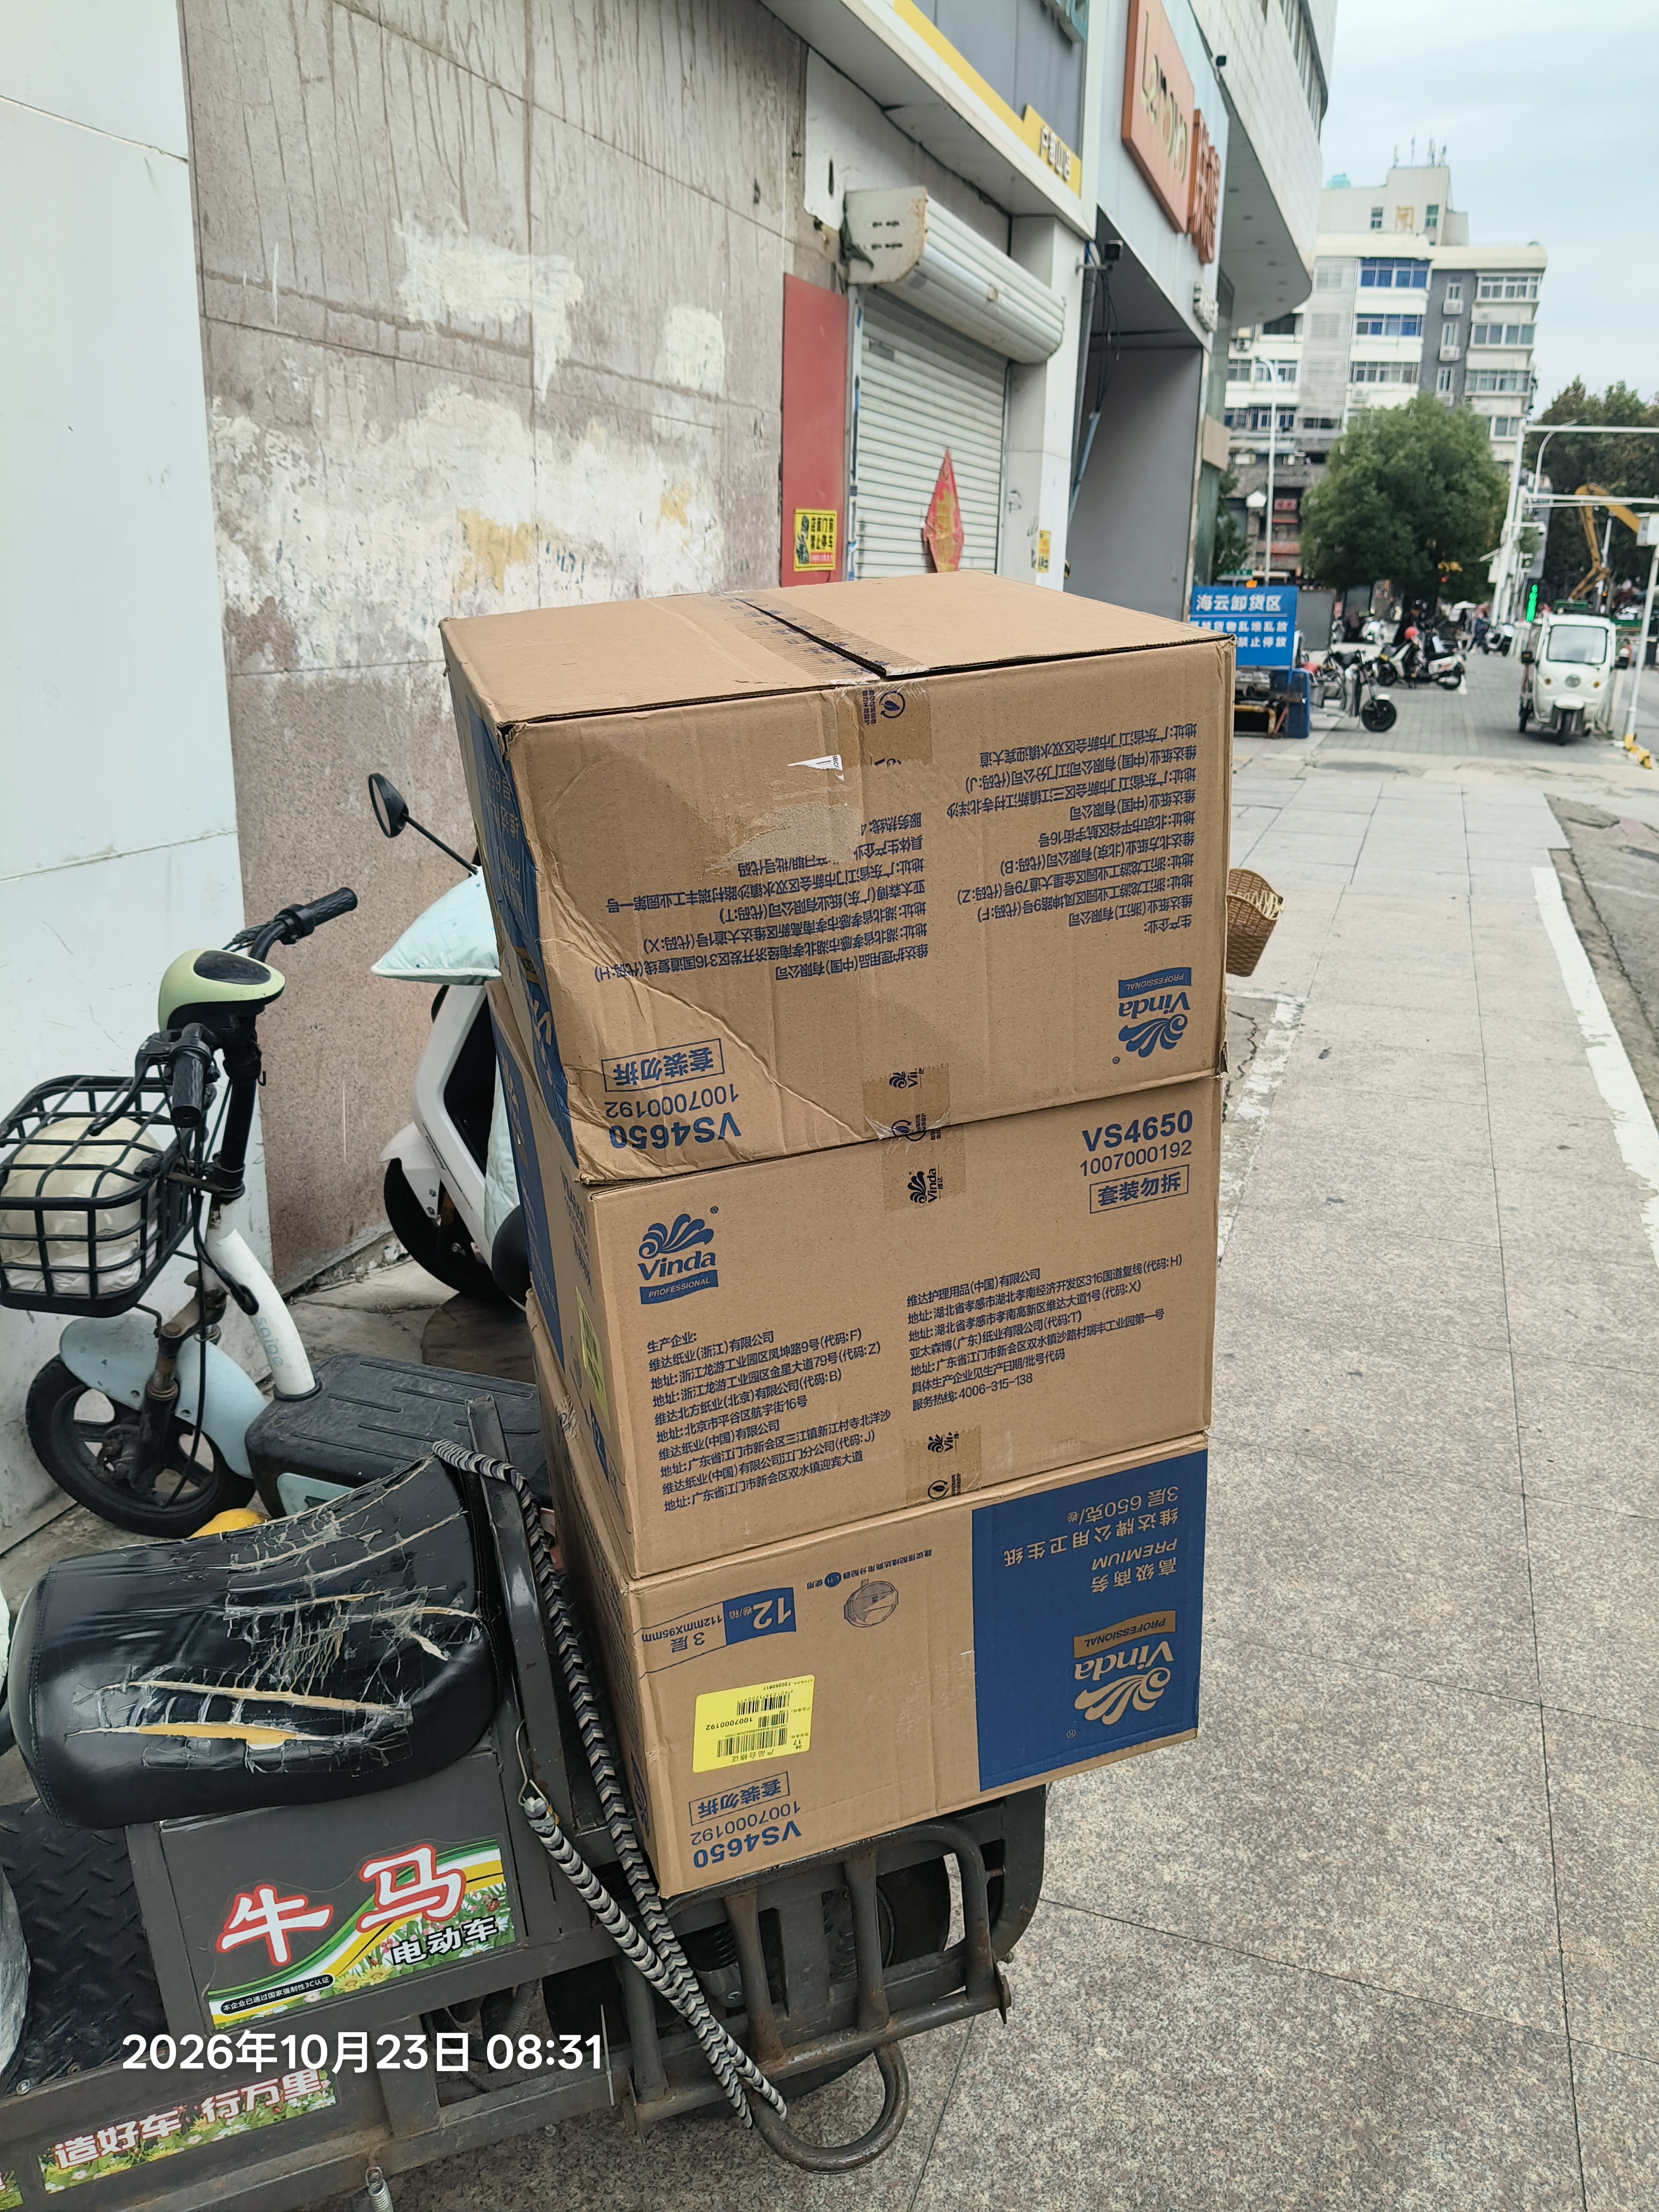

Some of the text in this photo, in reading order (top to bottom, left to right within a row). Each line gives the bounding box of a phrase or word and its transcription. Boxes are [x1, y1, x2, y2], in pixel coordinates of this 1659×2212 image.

[1070, 790, 1196, 822] 维达纸业(中国)有限公司
[1000, 833, 1195, 877] 维达北方纸业(北京)有限公司(代码:B)
[719, 880, 925, 925] 亚太森博(广东)纸业有限公司(代码:T)
[1069, 895, 1192, 928] 维达纸业(浙江)有限公司
[1143, 915, 1192, 934] 生产企业:
[775, 945, 928, 981] 维达护理用品(中国)有限公司
[1125, 973, 1185, 991] PROFESSIONAL
[1118, 992, 1191, 1019] Vinda
[613, 1047, 714, 1086] 套装勿拆
[604, 1083, 739, 1118] 1007000192
[609, 1112, 742, 1150] VS4650
[1081, 1109, 1193, 1152] VS4650
[1080, 1139, 1192, 1177] 1007000192
[927, 1168, 938, 1203] Vinda
[1097, 1171, 1181, 1208] 套装勿拆
[637, 1250, 716, 1281] Vinda
[648, 1277, 711, 1298] PROFESSIONAL
[907, 1269, 1040, 1307] 维达护理用品(中国)有限公司
[258, 1317, 284, 1366] saige
[648, 1334, 697, 1354] 生产企业:
[649, 1332, 774, 1372] 维达纸业(浙江)有限公司
[911, 1311, 1083, 1360] 亚太森博(广东)纸业有限公司(代码:T)
[913, 1349, 1065, 1394] 具体生产企业见生产日期/批号代码
[655, 1370, 841, 1426] 维达北方纸业(北京)有限公司(代码:B)
[913, 1374, 1033, 1412] 服务热线:4006-315-138
[659, 1420, 780, 1461] 维达纸业(中国)有限公司
[1003, 1507, 1178, 1567] 维达牌公用卫生纸
[1091, 1538, 1178, 1570] PREMIUM
[1091, 1556, 1177, 1593] 高级商务
[1084, 1617, 1166, 1648] PROFESSIONAL
[1074, 1641, 1175, 1681] Vinda
[705, 1716, 753, 1730] 1007000192
[731, 1748, 775, 1763] 产品合格证
[698, 1778, 781, 1819] 套装勿拆
[690, 1800, 802, 1846] 1007000192
[693, 1820, 802, 1869] VS4650
[217, 1844, 467, 1966] 牛马
[392, 1914, 500, 1966] 电动车
[222, 1975, 331, 2012] 本企业已通过国家强制性3C认证
[54, 2068, 327, 2169] 造好车 行万里
